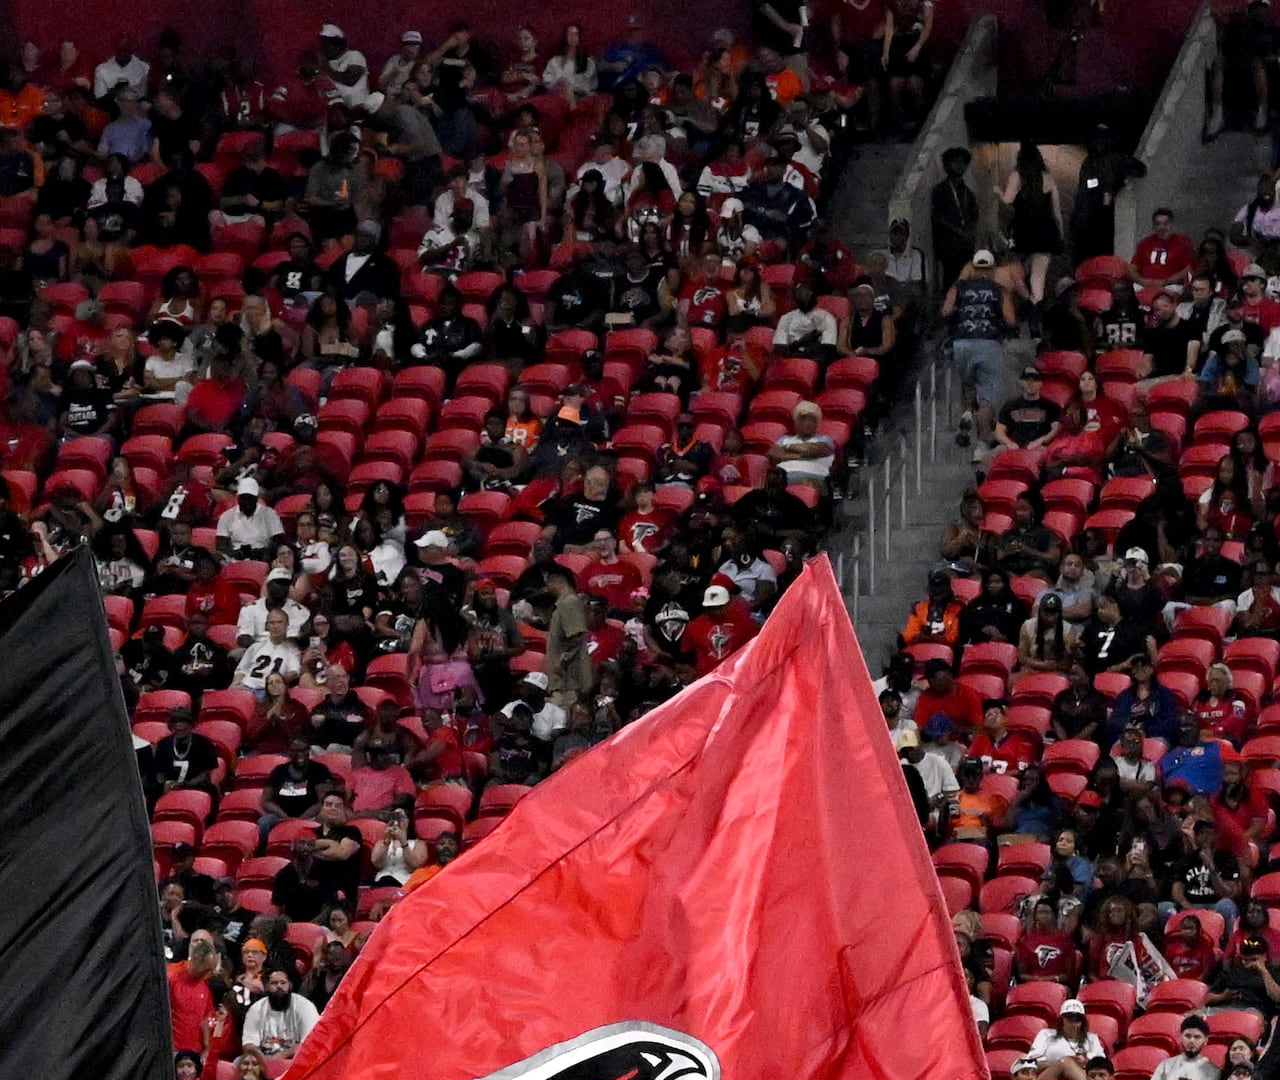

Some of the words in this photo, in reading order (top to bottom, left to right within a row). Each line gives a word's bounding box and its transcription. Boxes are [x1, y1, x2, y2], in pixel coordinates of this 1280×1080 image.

[1097, 631, 1116, 659] 7
[251, 655, 285, 678] 21
[173, 761, 190, 783] 7
